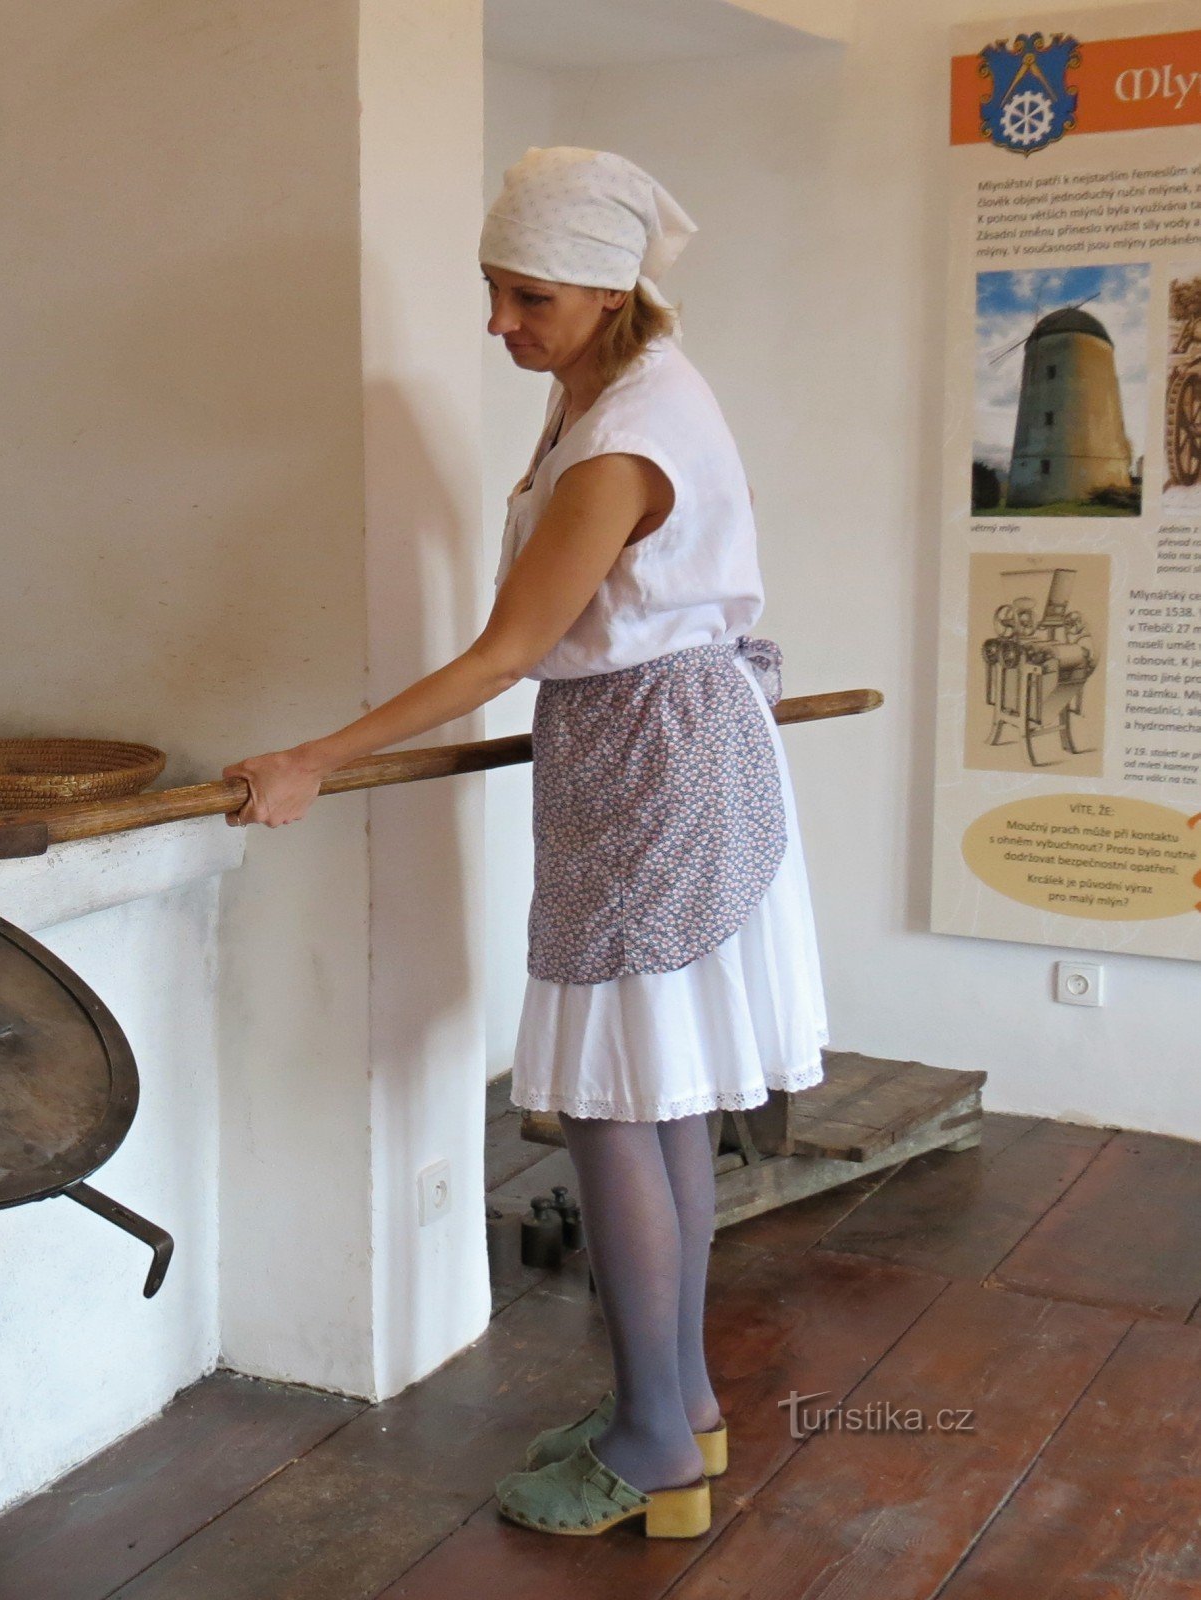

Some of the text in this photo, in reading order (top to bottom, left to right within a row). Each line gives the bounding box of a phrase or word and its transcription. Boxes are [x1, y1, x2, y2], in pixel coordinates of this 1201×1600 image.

[1115, 63, 1201, 110] Mly
[1035, 176, 1060, 188] patří
[1073, 171, 1128, 185] nejstarším
[1050, 188, 1114, 205] jednoduchý
[1118, 186, 1145, 197] ruční
[987, 214, 1027, 225] pohonu
[1030, 208, 1067, 221] větších
[1107, 204, 1129, 216] byla
[977, 228, 1016, 241] Zásadní
[1019, 226, 1054, 238] změnu
[1058, 224, 1101, 238] přineslo
[1163, 217, 1190, 229] vody
[1013, 245, 1020, 254] V
[1023, 241, 1084, 254] současnosti
[1087, 241, 1109, 253] jsou
[1113, 238, 1146, 250] mlýny
[1150, 233, 1201, 248] poháněn
[999, 524, 1020, 534] mlýn
[1130, 590, 1185, 602] Mlynářský
[1128, 608, 1135, 616] v
[1138, 608, 1162, 616] roce
[1166, 607, 1195, 617] 1538.
[1128, 624, 1135, 632] v
[1138, 622, 1174, 633] Třebíči
[1177, 623, 1190, 633] 27
[1127, 640, 1163, 649] museli
[1166, 640, 1196, 650] umět
[1132, 655, 1178, 666] obnovit.
[1181, 657, 1189, 666] K
[1126, 672, 1158, 681] mimo
[1160, 672, 1181, 684] jiné
[1126, 689, 1139, 697] na
[1142, 688, 1180, 699] zámku.
[1125, 703, 1184, 717] řemeslníci,
[1125, 721, 1131, 729] a
[1006, 820, 1179, 842] Moučný prach může při kontaktu
[997, 836, 1033, 846] ohněm
[1036, 839, 1103, 852] vybuchnout?
[1106, 844, 1135, 855] Proto
[1137, 846, 1161, 858] bylo
[1164, 849, 1197, 860] nutné
[1004, 851, 1179, 875] dodržovat bezpečnostní opatření.
[1066, 877, 1077, 888] je
[1079, 879, 1122, 890] původní
[1125, 883, 1153, 894] výraz
[1048, 893, 1129, 908] pro malý mlýn?
